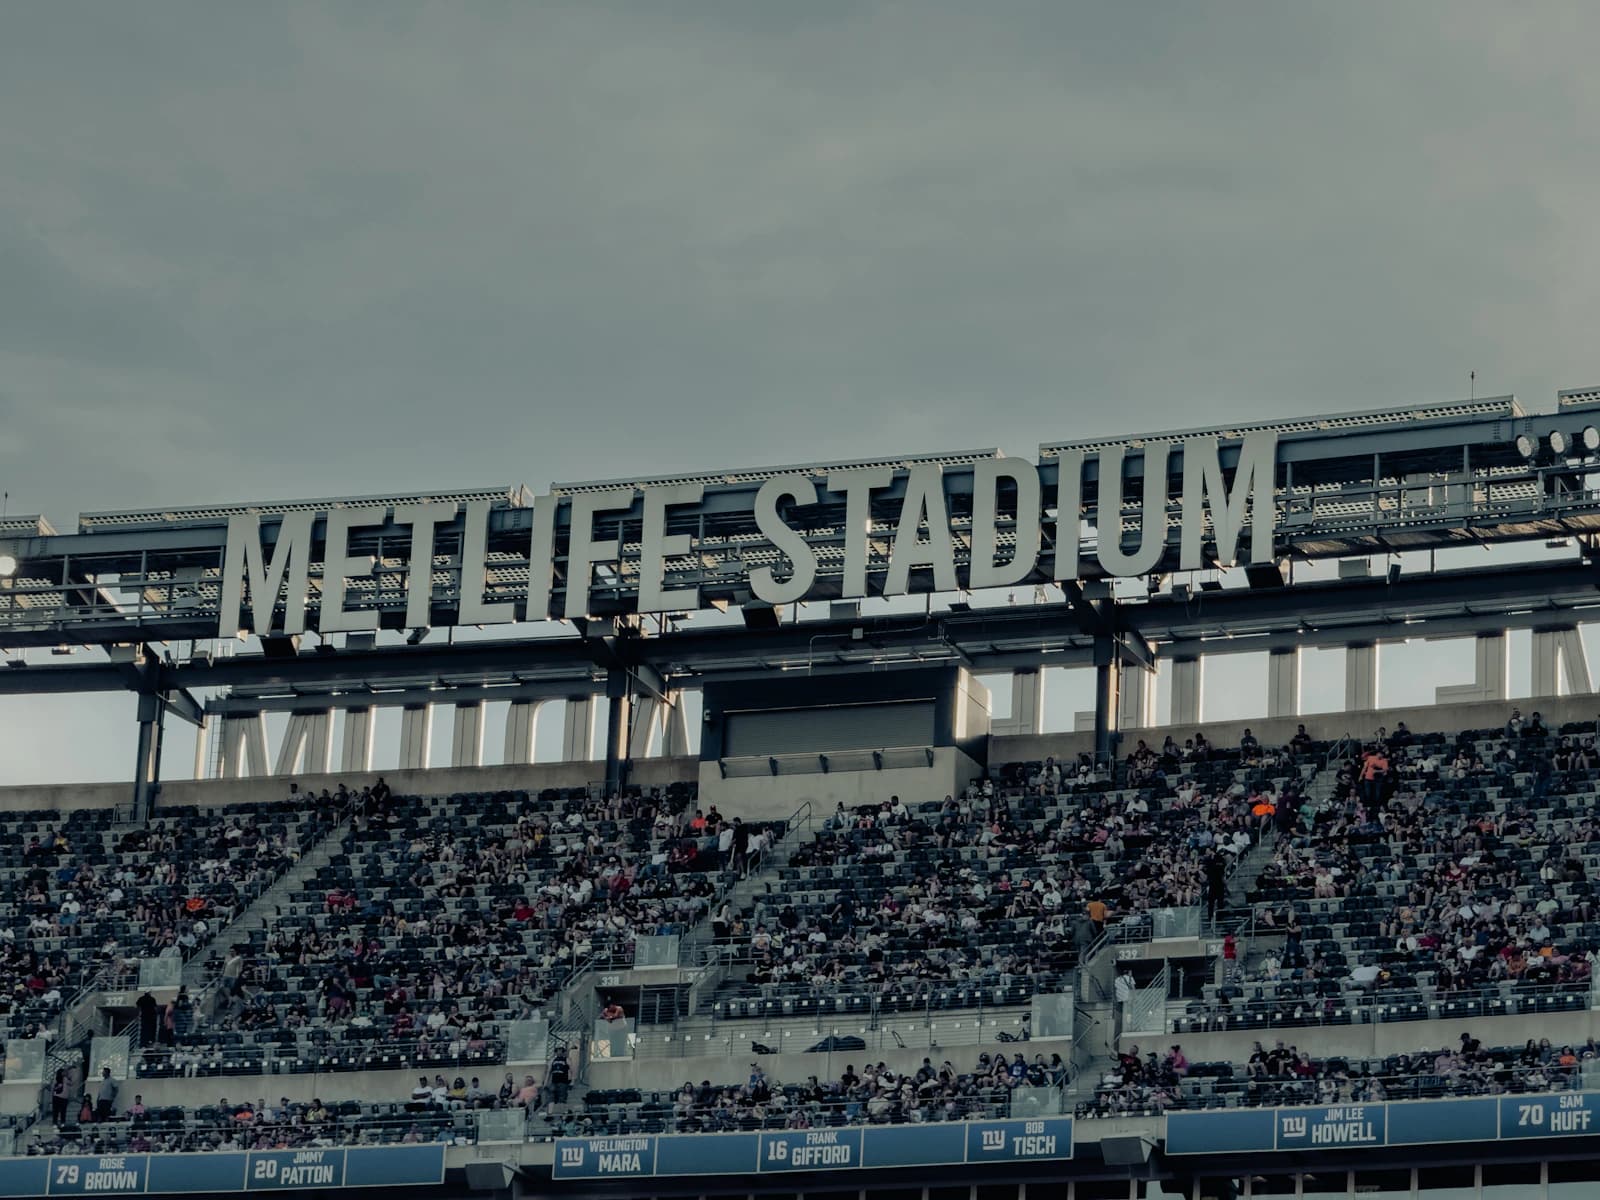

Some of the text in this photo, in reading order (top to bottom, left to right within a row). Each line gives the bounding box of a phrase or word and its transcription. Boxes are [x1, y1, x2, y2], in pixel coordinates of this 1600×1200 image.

[218, 431, 1278, 638] METLIFE STADIUM
[1559, 1095, 1584, 1109] SAM
[1324, 1107, 1365, 1122] JIM LEE
[1518, 1105, 1543, 1125] 70
[1550, 1109, 1592, 1132] HUFF
[1025, 1121, 1045, 1135] BOB
[1312, 1121, 1377, 1144] HOWELL
[588, 1138, 649, 1153] WELLINGTON
[806, 1132, 837, 1145] FRANK
[1013, 1135, 1056, 1155] TISCH
[292, 1151, 325, 1164] JIMMY
[768, 1141, 787, 1160] 16
[791, 1145, 851, 1165] GIFFORD
[99, 1157, 126, 1170] ROSIE
[255, 1160, 278, 1179] 20
[599, 1154, 641, 1173] MARA
[57, 1166, 79, 1184] 79
[85, 1171, 137, 1190] BROWN
[281, 1165, 334, 1185] PATTON
